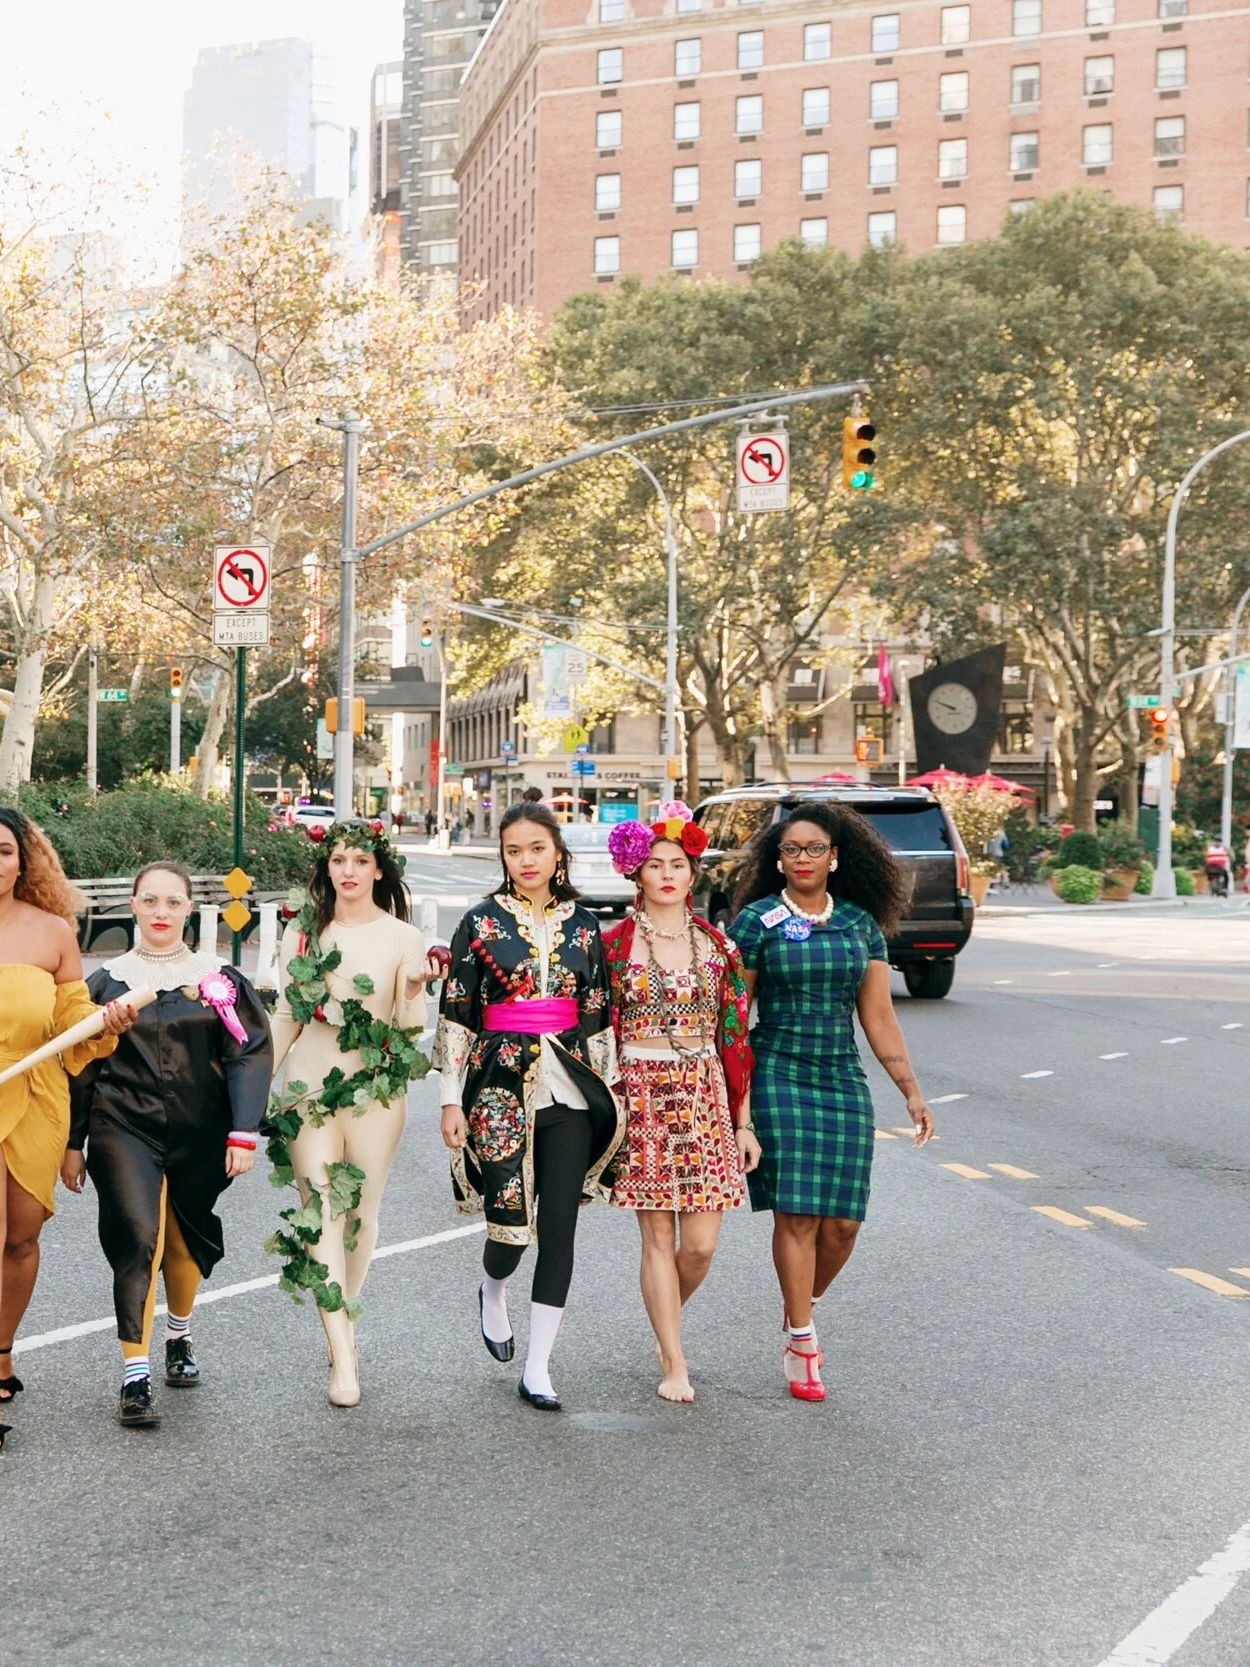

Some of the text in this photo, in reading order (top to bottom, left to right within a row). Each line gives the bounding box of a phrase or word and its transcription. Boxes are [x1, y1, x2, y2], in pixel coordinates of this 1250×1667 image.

[226, 617, 256, 628] EXCEPT
[219, 631, 264, 642] MTA BUSES
[568, 662, 584, 673] 25
[605, 772, 641, 780] COFFEE
[764, 909, 788, 925] NASA
[785, 924, 810, 938] NASA
